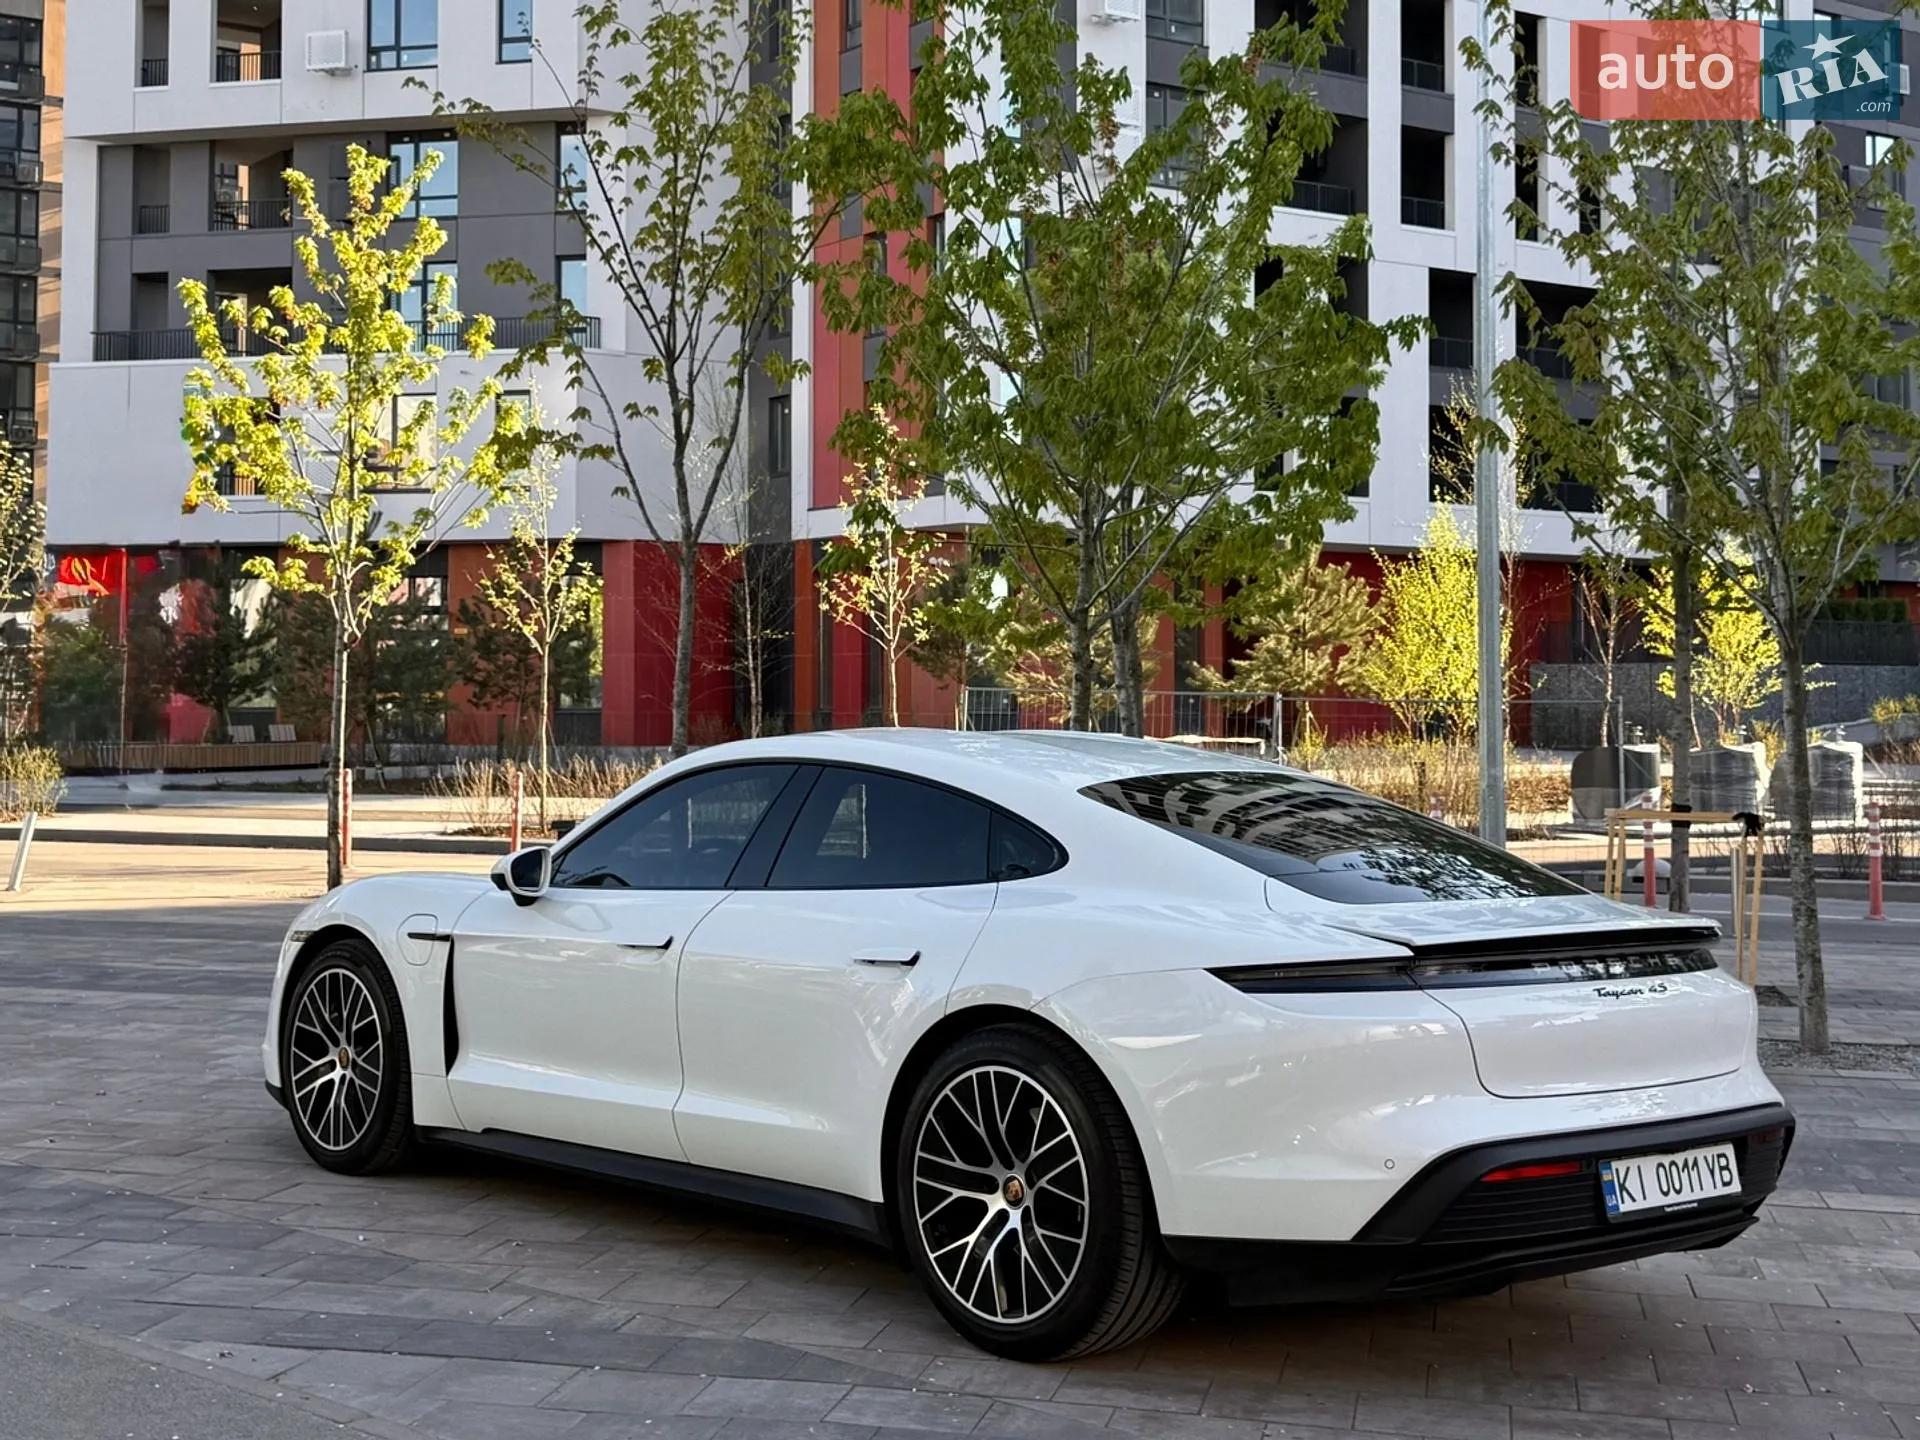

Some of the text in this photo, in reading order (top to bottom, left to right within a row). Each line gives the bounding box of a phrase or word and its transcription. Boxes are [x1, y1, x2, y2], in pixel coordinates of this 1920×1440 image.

[1593, 982, 1668, 1000] Taycan 4S
[1615, 1152, 1734, 1204] KI 0011 YB
